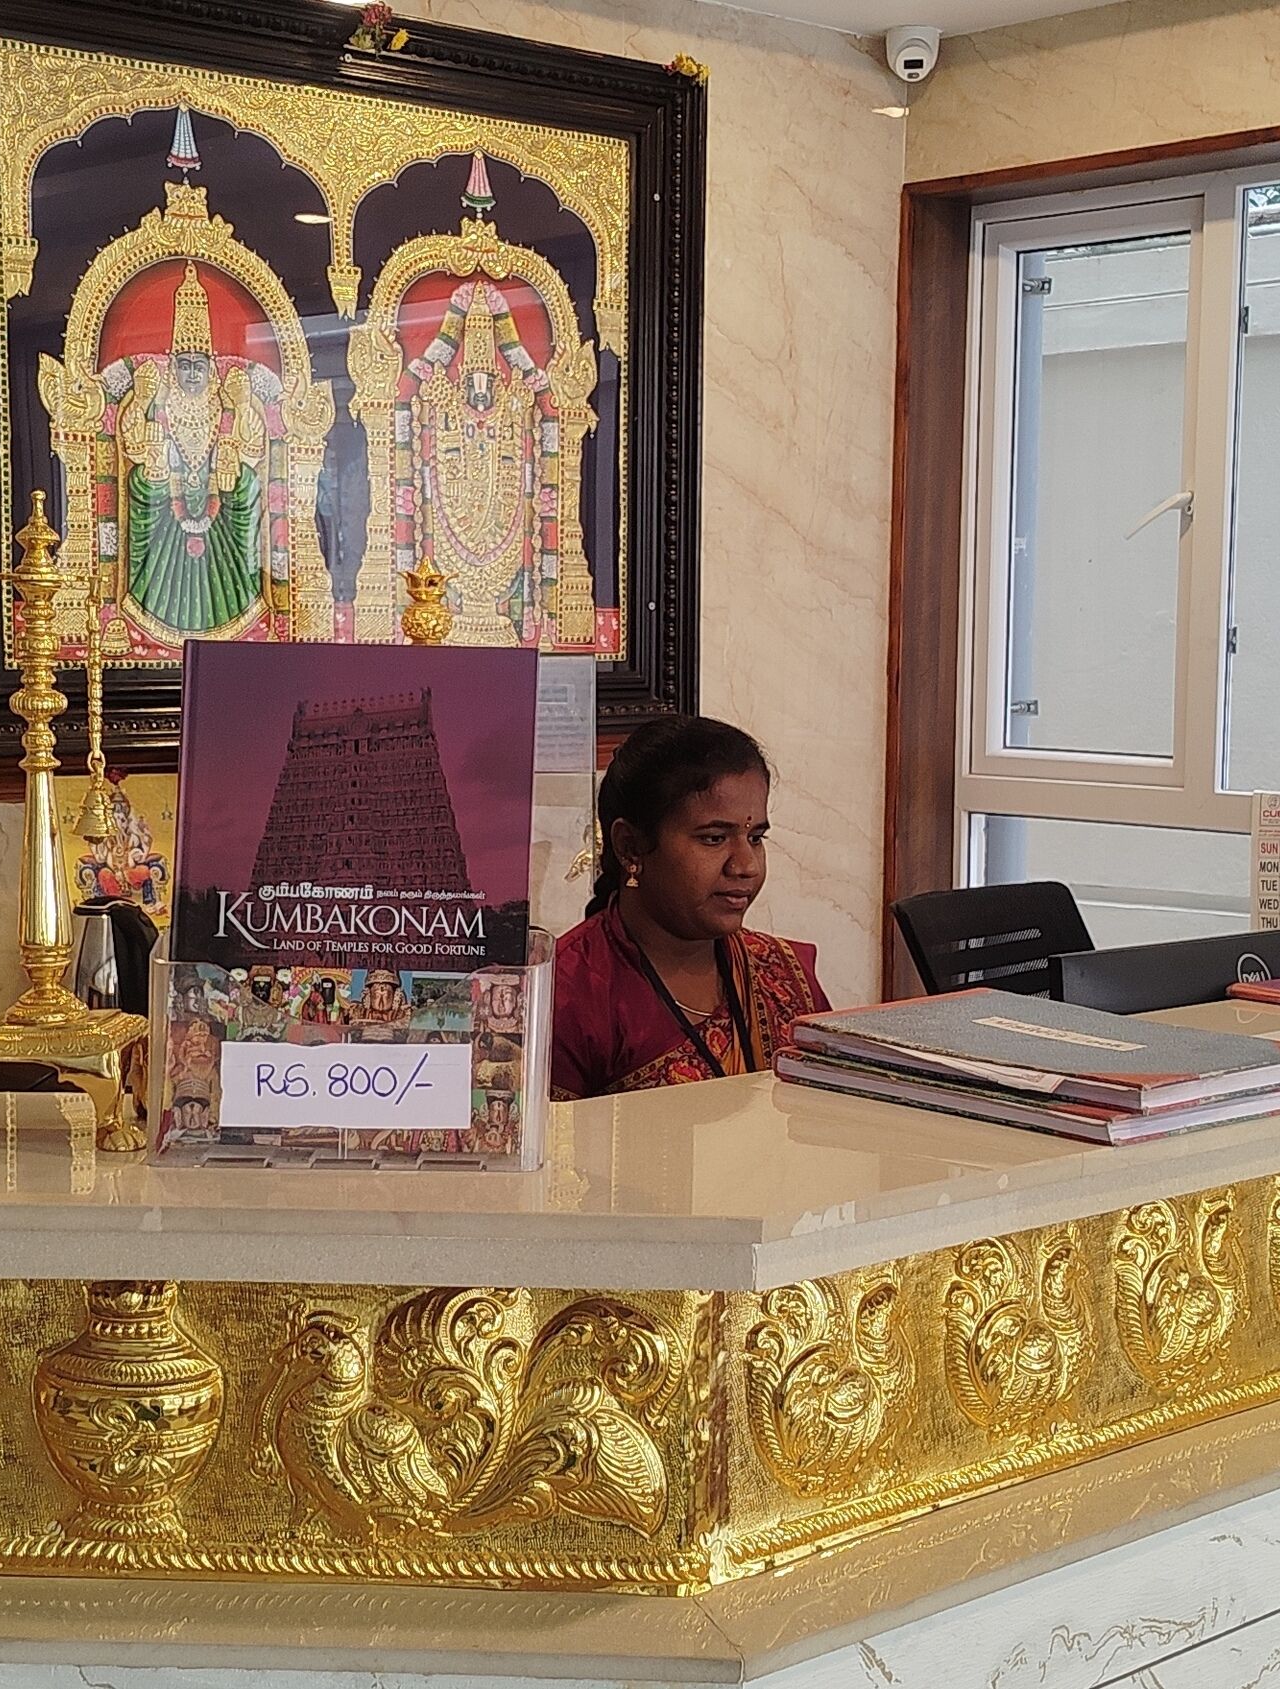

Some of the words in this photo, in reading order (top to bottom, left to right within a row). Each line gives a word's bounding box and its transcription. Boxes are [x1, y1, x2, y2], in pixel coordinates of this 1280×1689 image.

[1261, 843, 1278, 854] SUN
[1259, 862, 1278, 872] MON
[258, 882, 374, 900] கும்பகோணம்
[1261, 880, 1277, 891] TUE
[1259, 898, 1279, 910] WED
[214, 891, 486, 949] KUMBAKONAM
[1261, 917, 1278, 928] THU
[273, 938, 305, 950] LAND
[306, 940, 322, 951] OF
[323, 941, 369, 952] TEMPLES
[371, 943, 394, 953] FOR
[396, 942, 432, 955] GOOD
[435, 944, 486, 956] FORTUNE
[328, 1052, 432, 1105] 800/-
